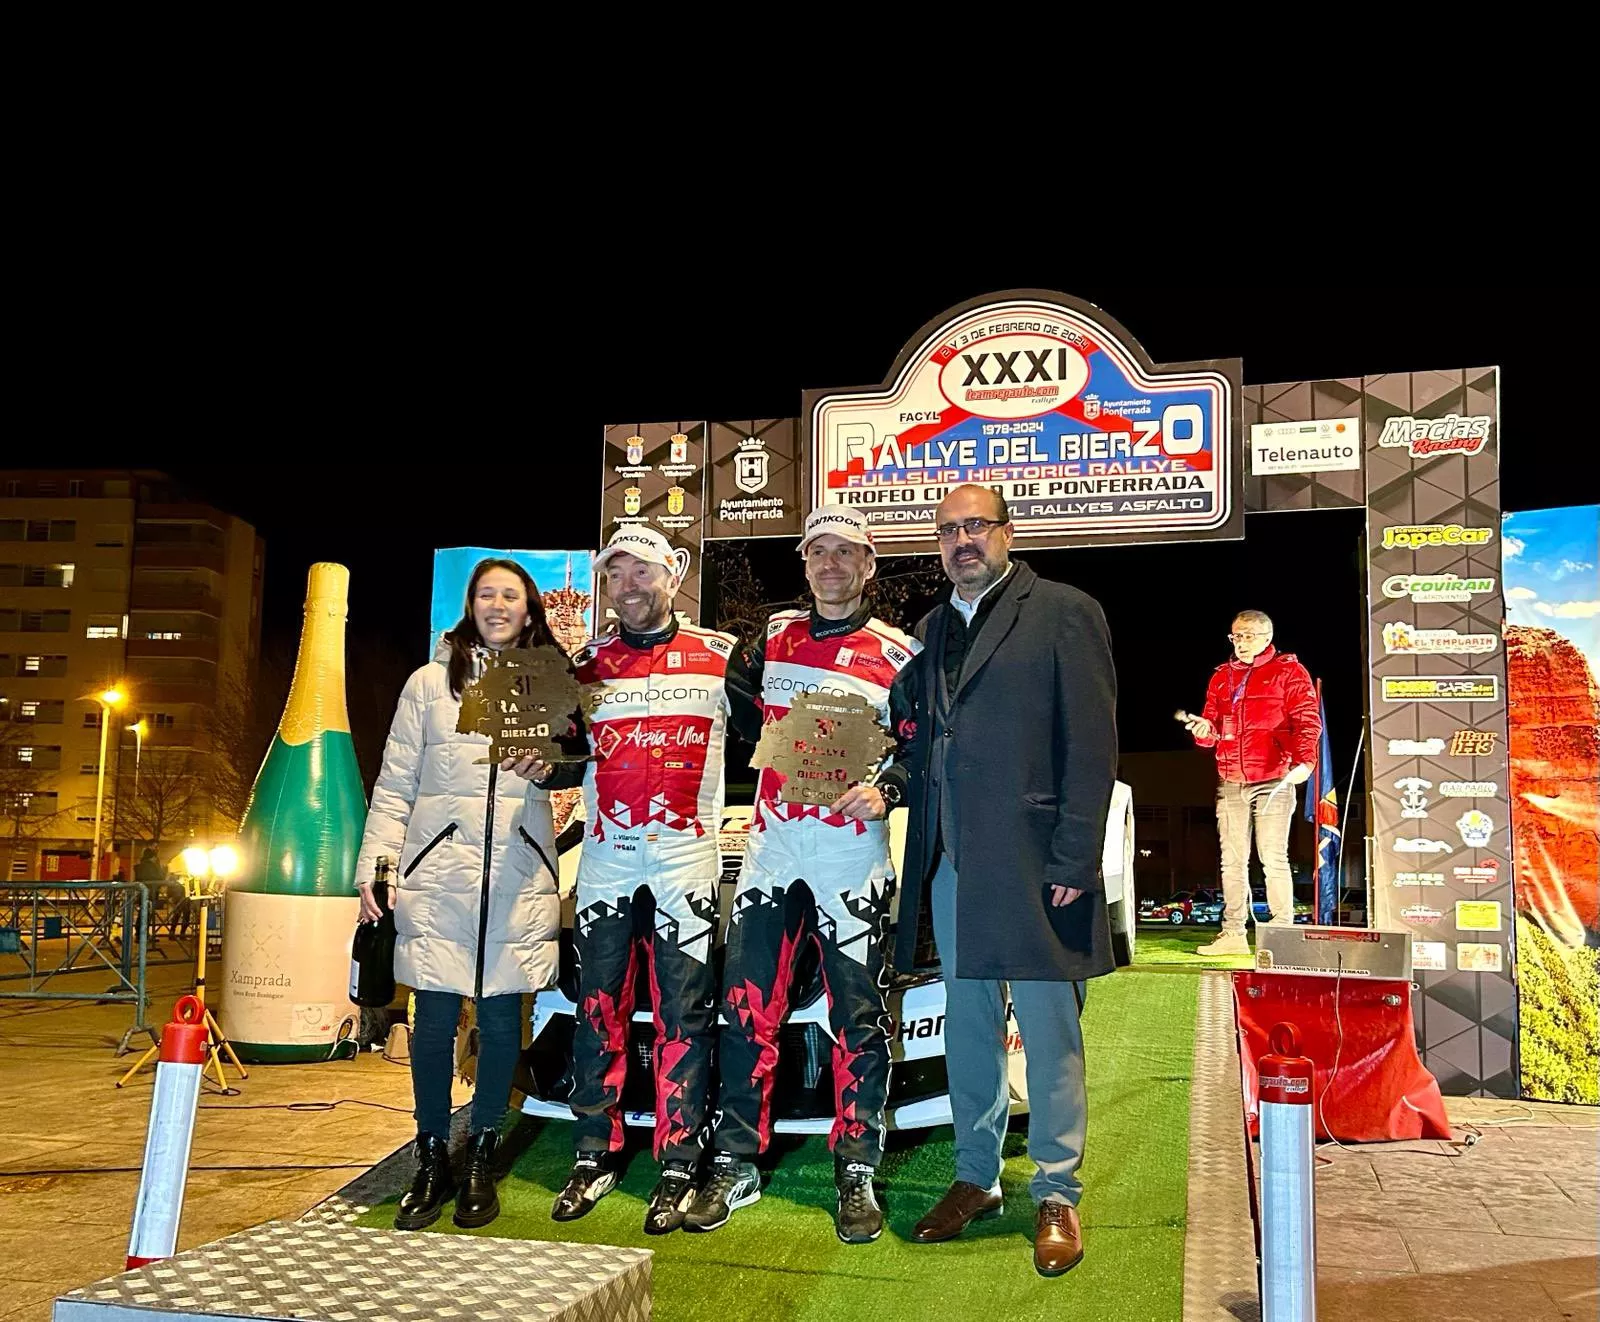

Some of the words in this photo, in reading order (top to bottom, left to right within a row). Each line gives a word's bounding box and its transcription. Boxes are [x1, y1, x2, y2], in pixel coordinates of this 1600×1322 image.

[941, 348, 952, 358] 2
[950, 340, 958, 349] Y
[960, 335, 969, 344] 3
[970, 328, 986, 340] DE
[988, 322, 1041, 335] FEBRERO
[1043, 324, 1058, 335] DE
[1060, 330, 1089, 350] 2024
[961, 347, 1067, 387] XXXI
[1102, 407, 1151, 418] Ponferrada
[1103, 399, 1151, 408] Ayuntamiento
[982, 421, 1043, 435] 1978-2024
[988, 436, 1049, 465] DEL
[1059, 404, 1204, 461] BIERZO
[1258, 445, 1353, 463] Telenauto
[1413, 437, 1482, 454] Racing
[848, 470, 960, 487] FULLSLIP
[967, 463, 1081, 482] HISTORIC
[1088, 459, 1187, 476] RALLYE
[835, 489, 915, 504] TROFEO
[1013, 483, 1040, 497] DE
[1049, 475, 1205, 496] PONFERRADA
[720, 497, 783, 512] Ayuntamiento
[1030, 501, 1113, 516] RALLYES
[1119, 498, 1204, 513] ASFALTO
[720, 508, 784, 524] Ponferrada
[1383, 526, 1489, 546] JopeCar
[709, 640, 729, 650] OMP
[887, 648, 905, 662] OMP
[592, 688, 709, 707] econocom
[501, 723, 549, 738] BIERZO
[230, 970, 291, 989] Xamprada
